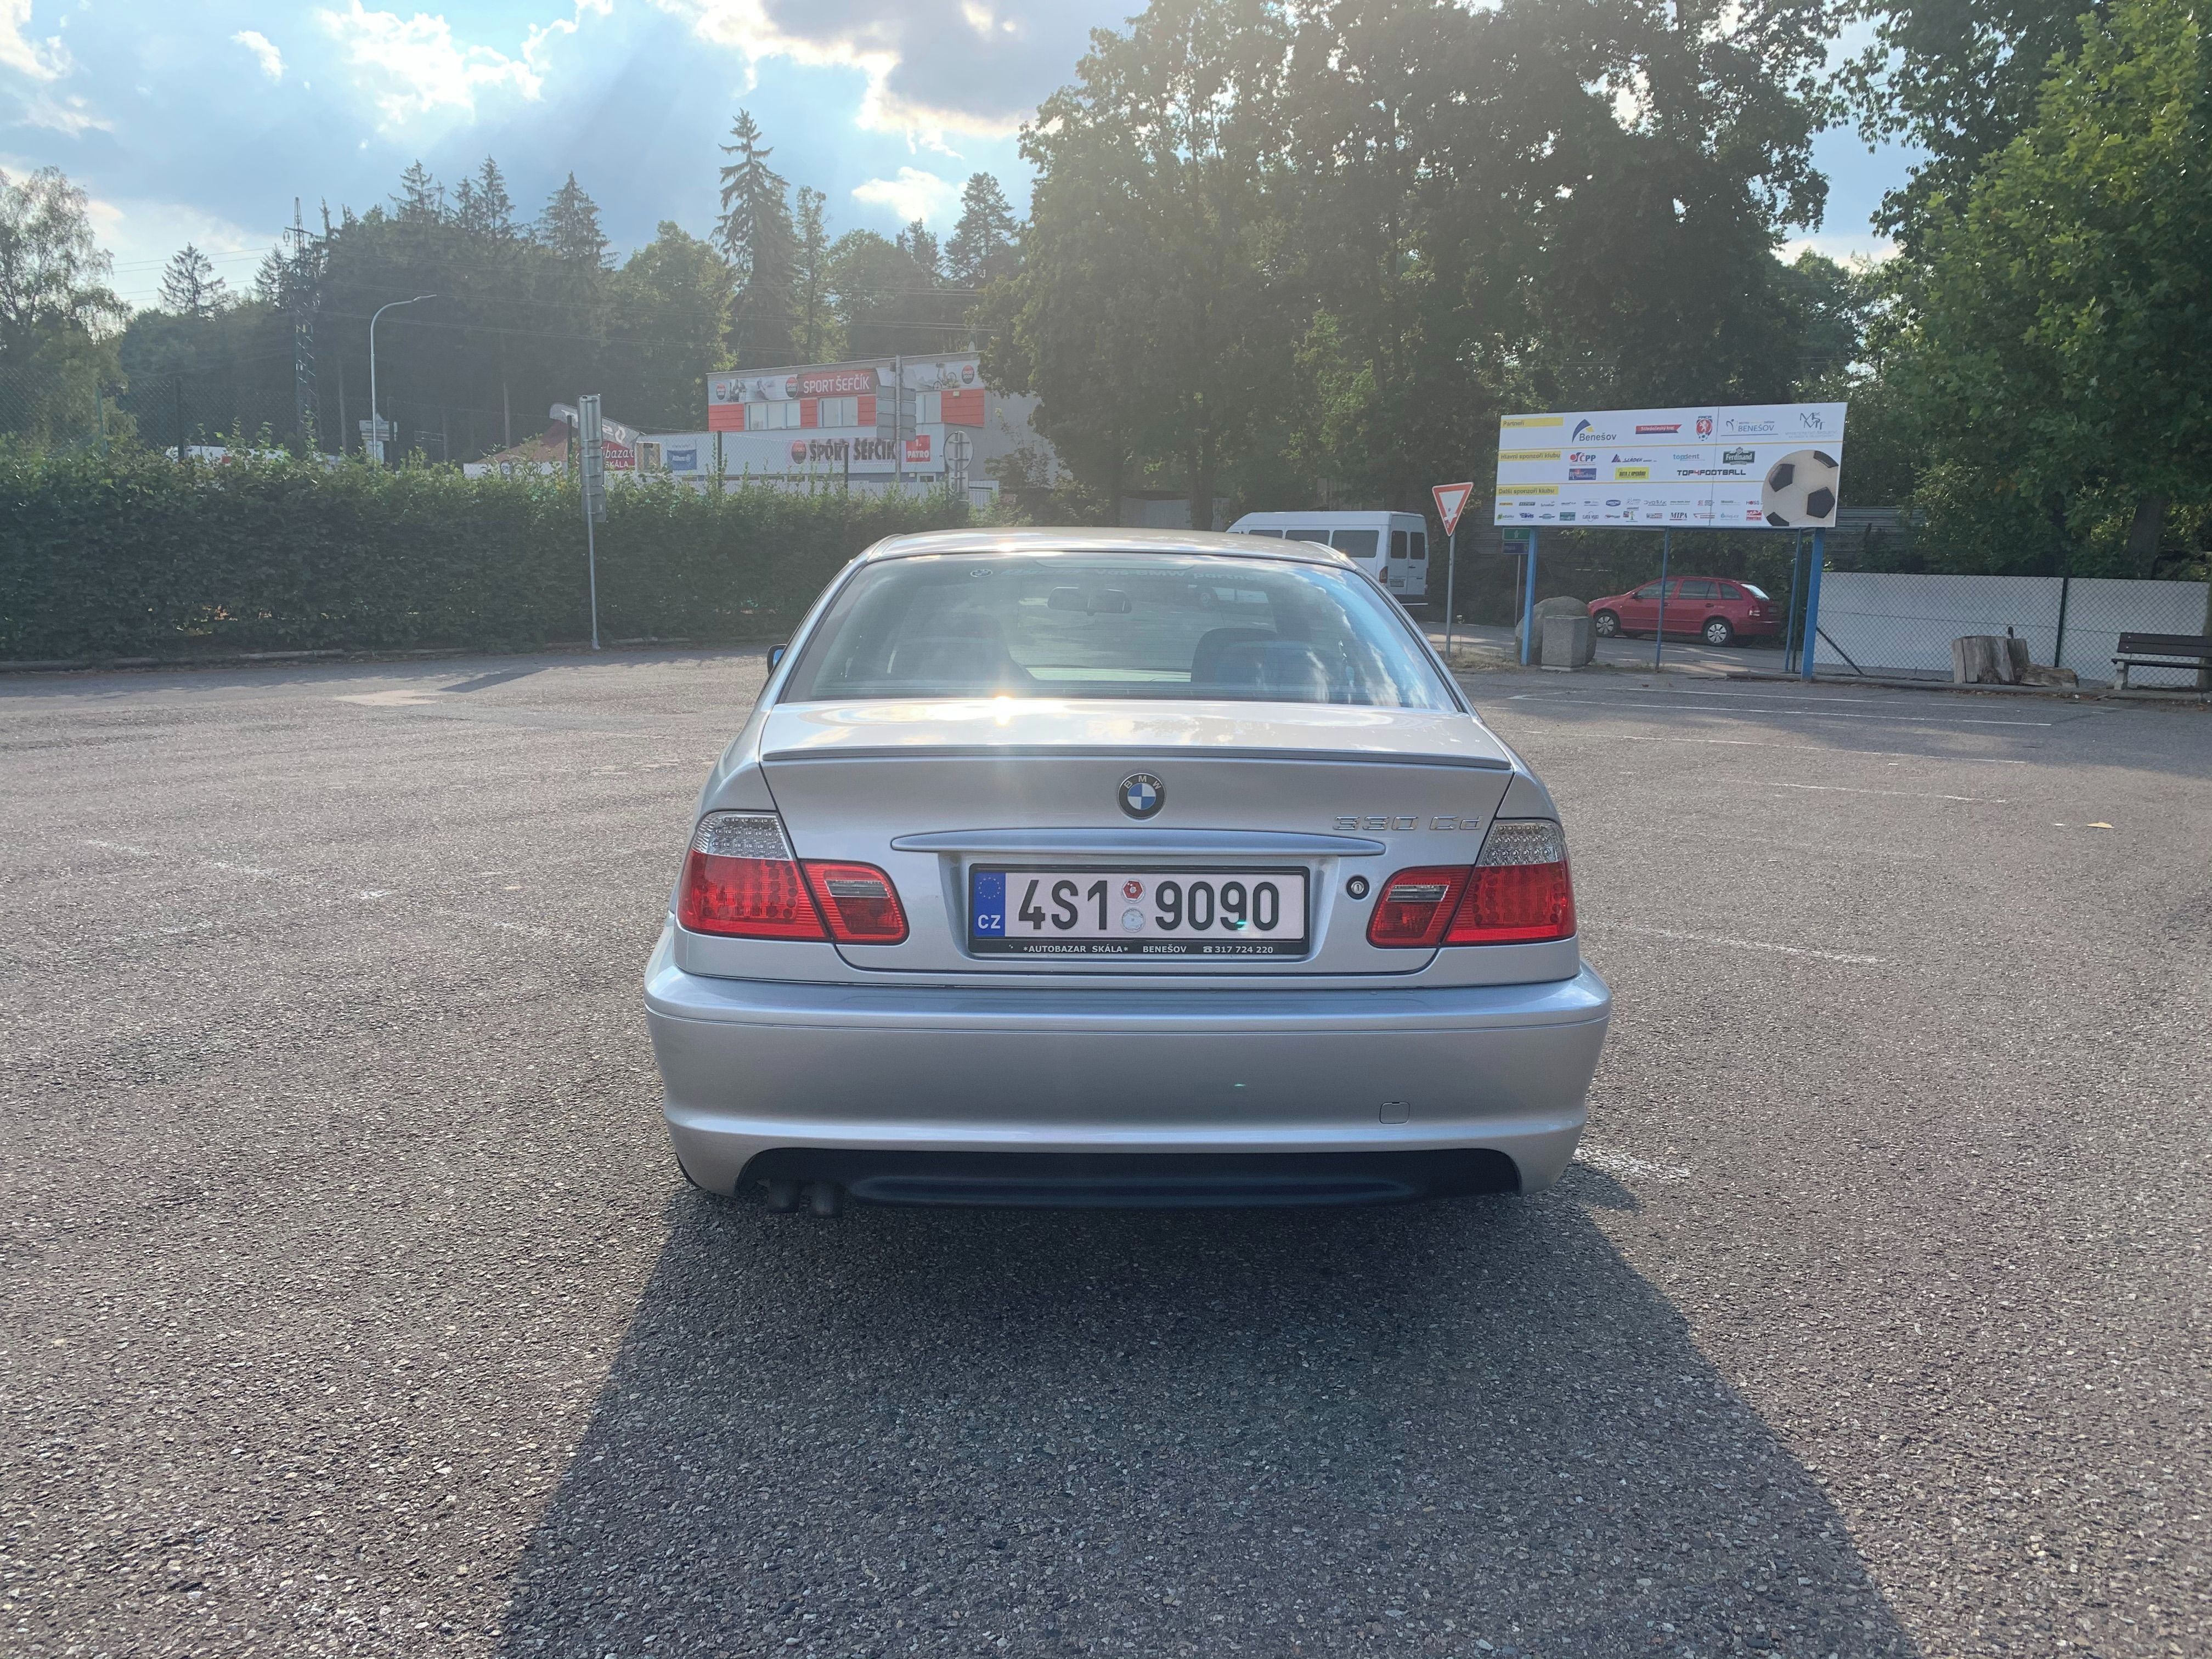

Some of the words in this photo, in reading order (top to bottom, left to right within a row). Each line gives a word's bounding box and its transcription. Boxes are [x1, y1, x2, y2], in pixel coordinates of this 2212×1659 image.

[804, 379, 834, 393] SPORT
[836, 374, 870, 391] ŠEFČÍK
[1579, 432, 1617, 441] Benešov
[810, 439, 848, 461] SPOR
[1580, 453, 1596, 462] ČPP
[1123, 775, 1162, 790] BMW
[1333, 816, 1419, 831] 330
[1429, 815, 1482, 831] Cd
[1018, 879, 1108, 930] 4S1
[1155, 881, 1280, 932] 9090
[978, 915, 1001, 929] CZ
[1143, 944, 1187, 953] BENEŠOV
[1233, 946, 1253, 954] 724
[1256, 946, 1273, 954] 220
